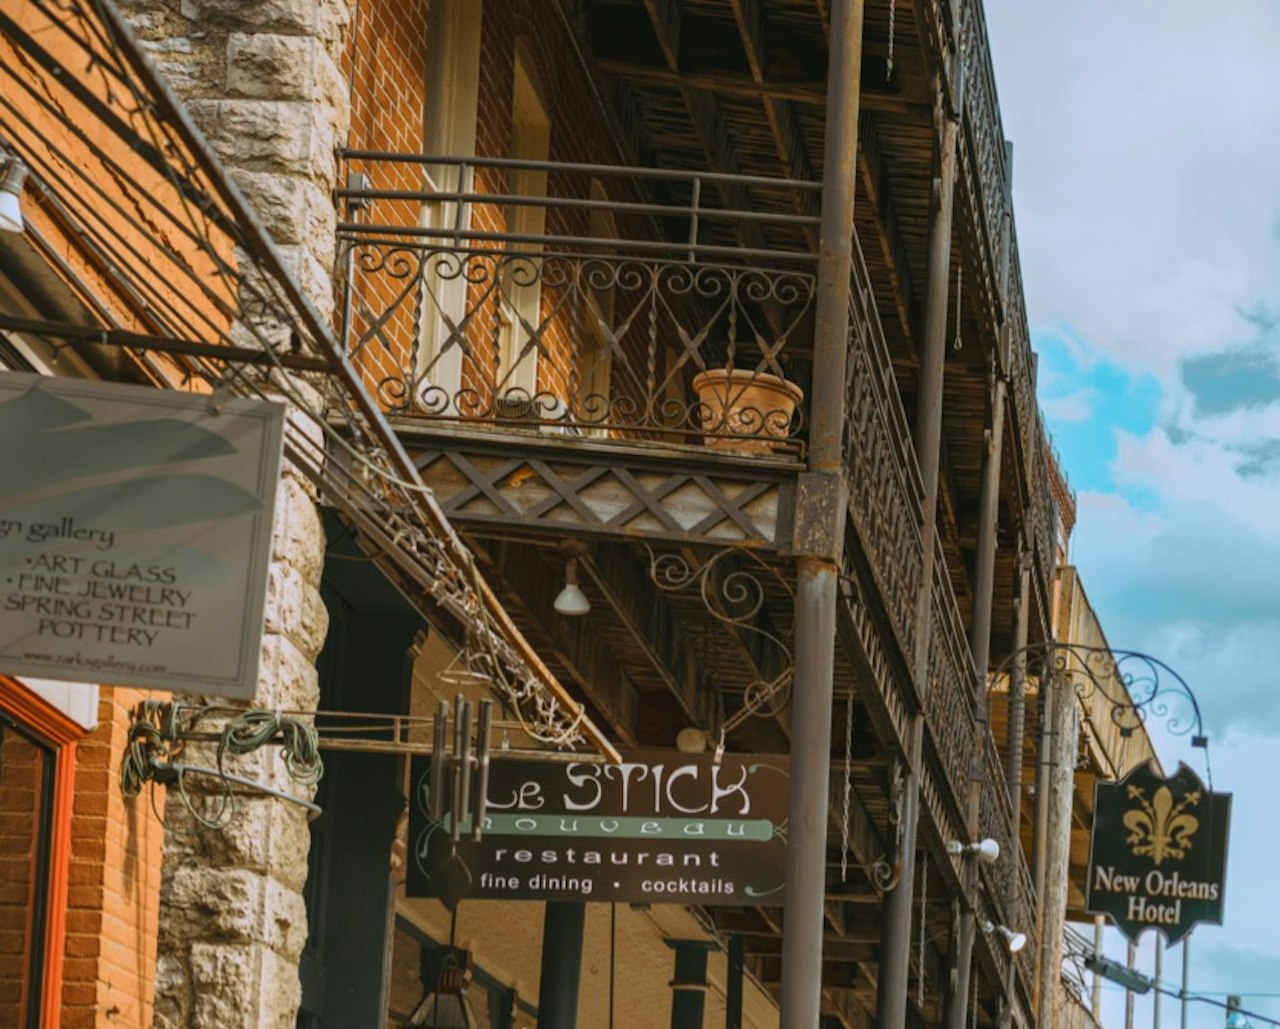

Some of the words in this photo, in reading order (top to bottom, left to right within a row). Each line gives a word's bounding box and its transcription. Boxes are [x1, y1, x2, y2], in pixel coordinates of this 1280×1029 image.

[26, 516, 115, 550] gallery
[32, 553, 84, 575] ART
[91, 560, 176, 584] GLASS
[18, 573, 70, 596] FINE
[77, 580, 191, 607] JEWELRY
[4, 592, 91, 620] SPRING
[98, 604, 197, 630] STREET
[38, 618, 159, 647] POTTERY
[563, 763, 750, 815] STICK
[494, 847, 720, 868] restaurant
[480, 872, 520, 889] fine
[528, 874, 593, 893] dining
[641, 878, 735, 895] cocktails
[1094, 865, 1141, 893] New
[1145, 870, 1219, 900] Orleans
[1126, 896, 1182, 925] Hotel
